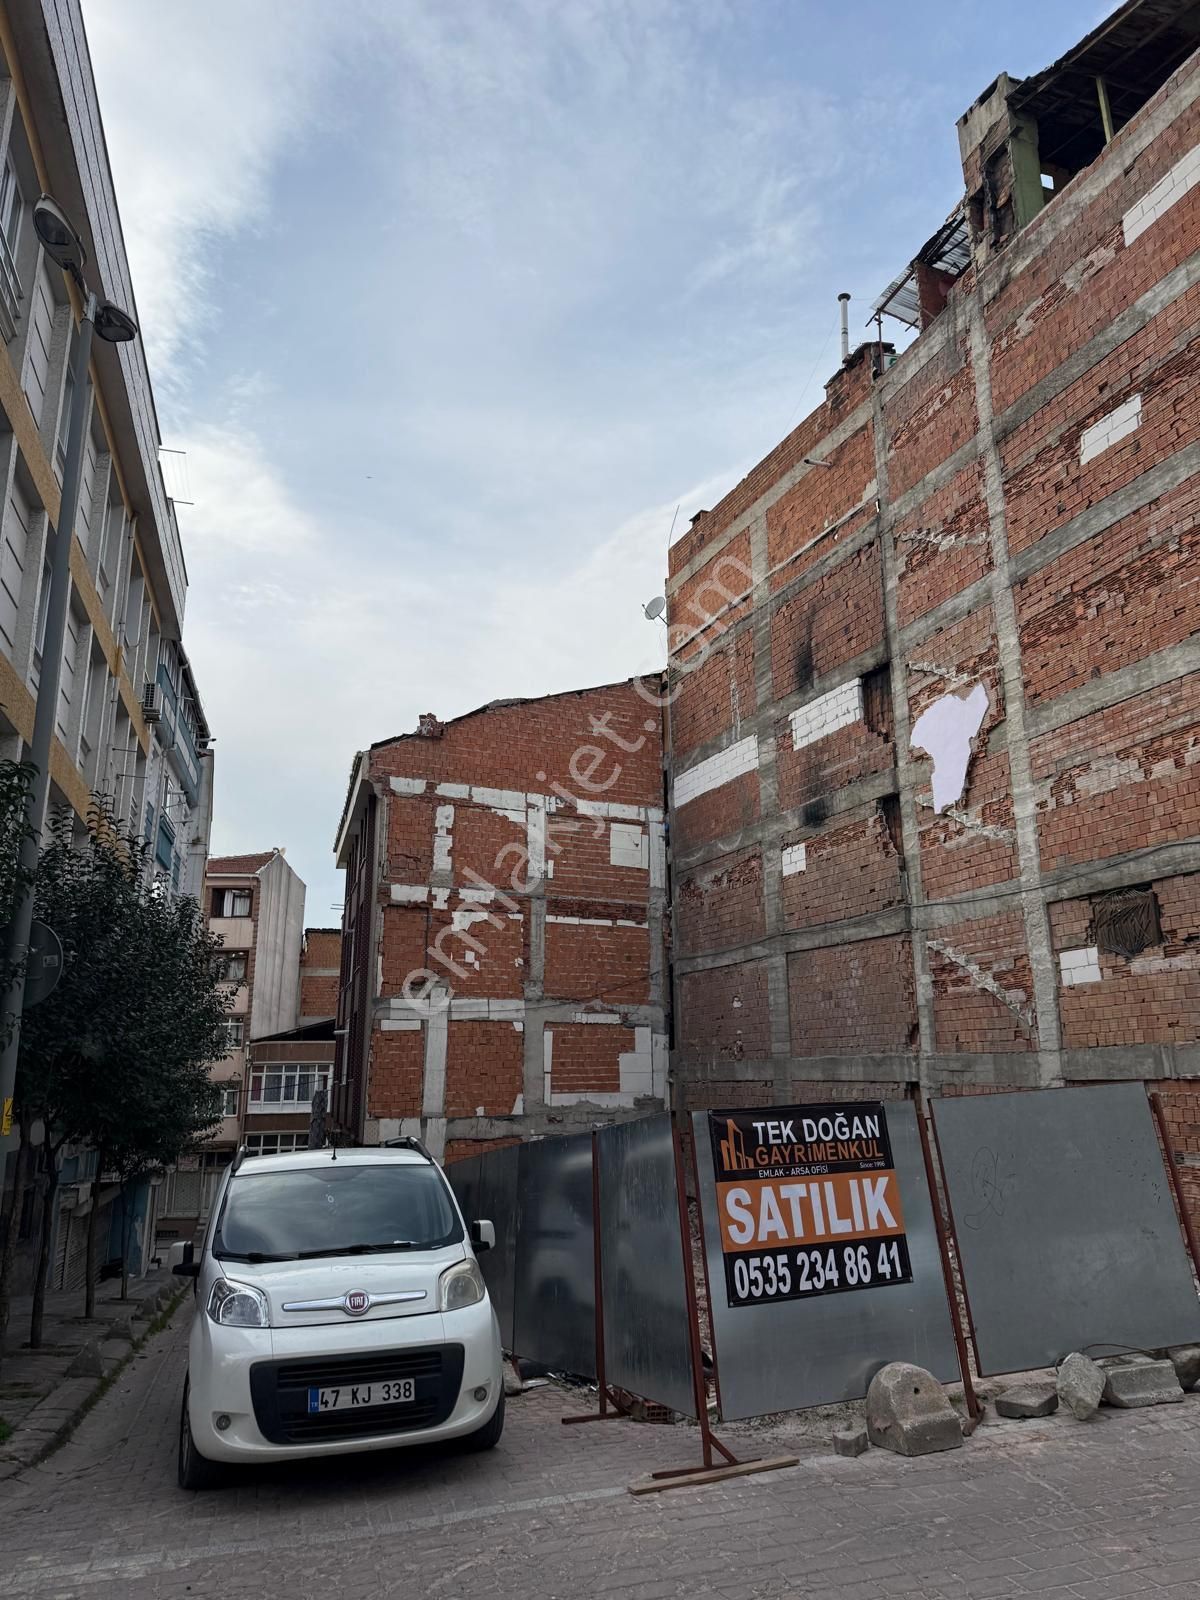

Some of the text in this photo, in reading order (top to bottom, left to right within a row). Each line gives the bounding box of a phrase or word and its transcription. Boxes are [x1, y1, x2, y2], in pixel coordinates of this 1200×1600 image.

[752, 1112, 881, 1145] TEK DOĞAN
[758, 1168, 784, 1178] EMLAK
[790, 1167, 811, 1176] ARSA
[725, 1177, 898, 1245] SATILIK
[733, 1241, 901, 1299] 0535 234 86 41
[350, 1296, 364, 1307] FIAT
[320, 1389, 340, 1408] 47
[351, 1386, 371, 1405] KJ
[382, 1381, 412, 1401] 338
